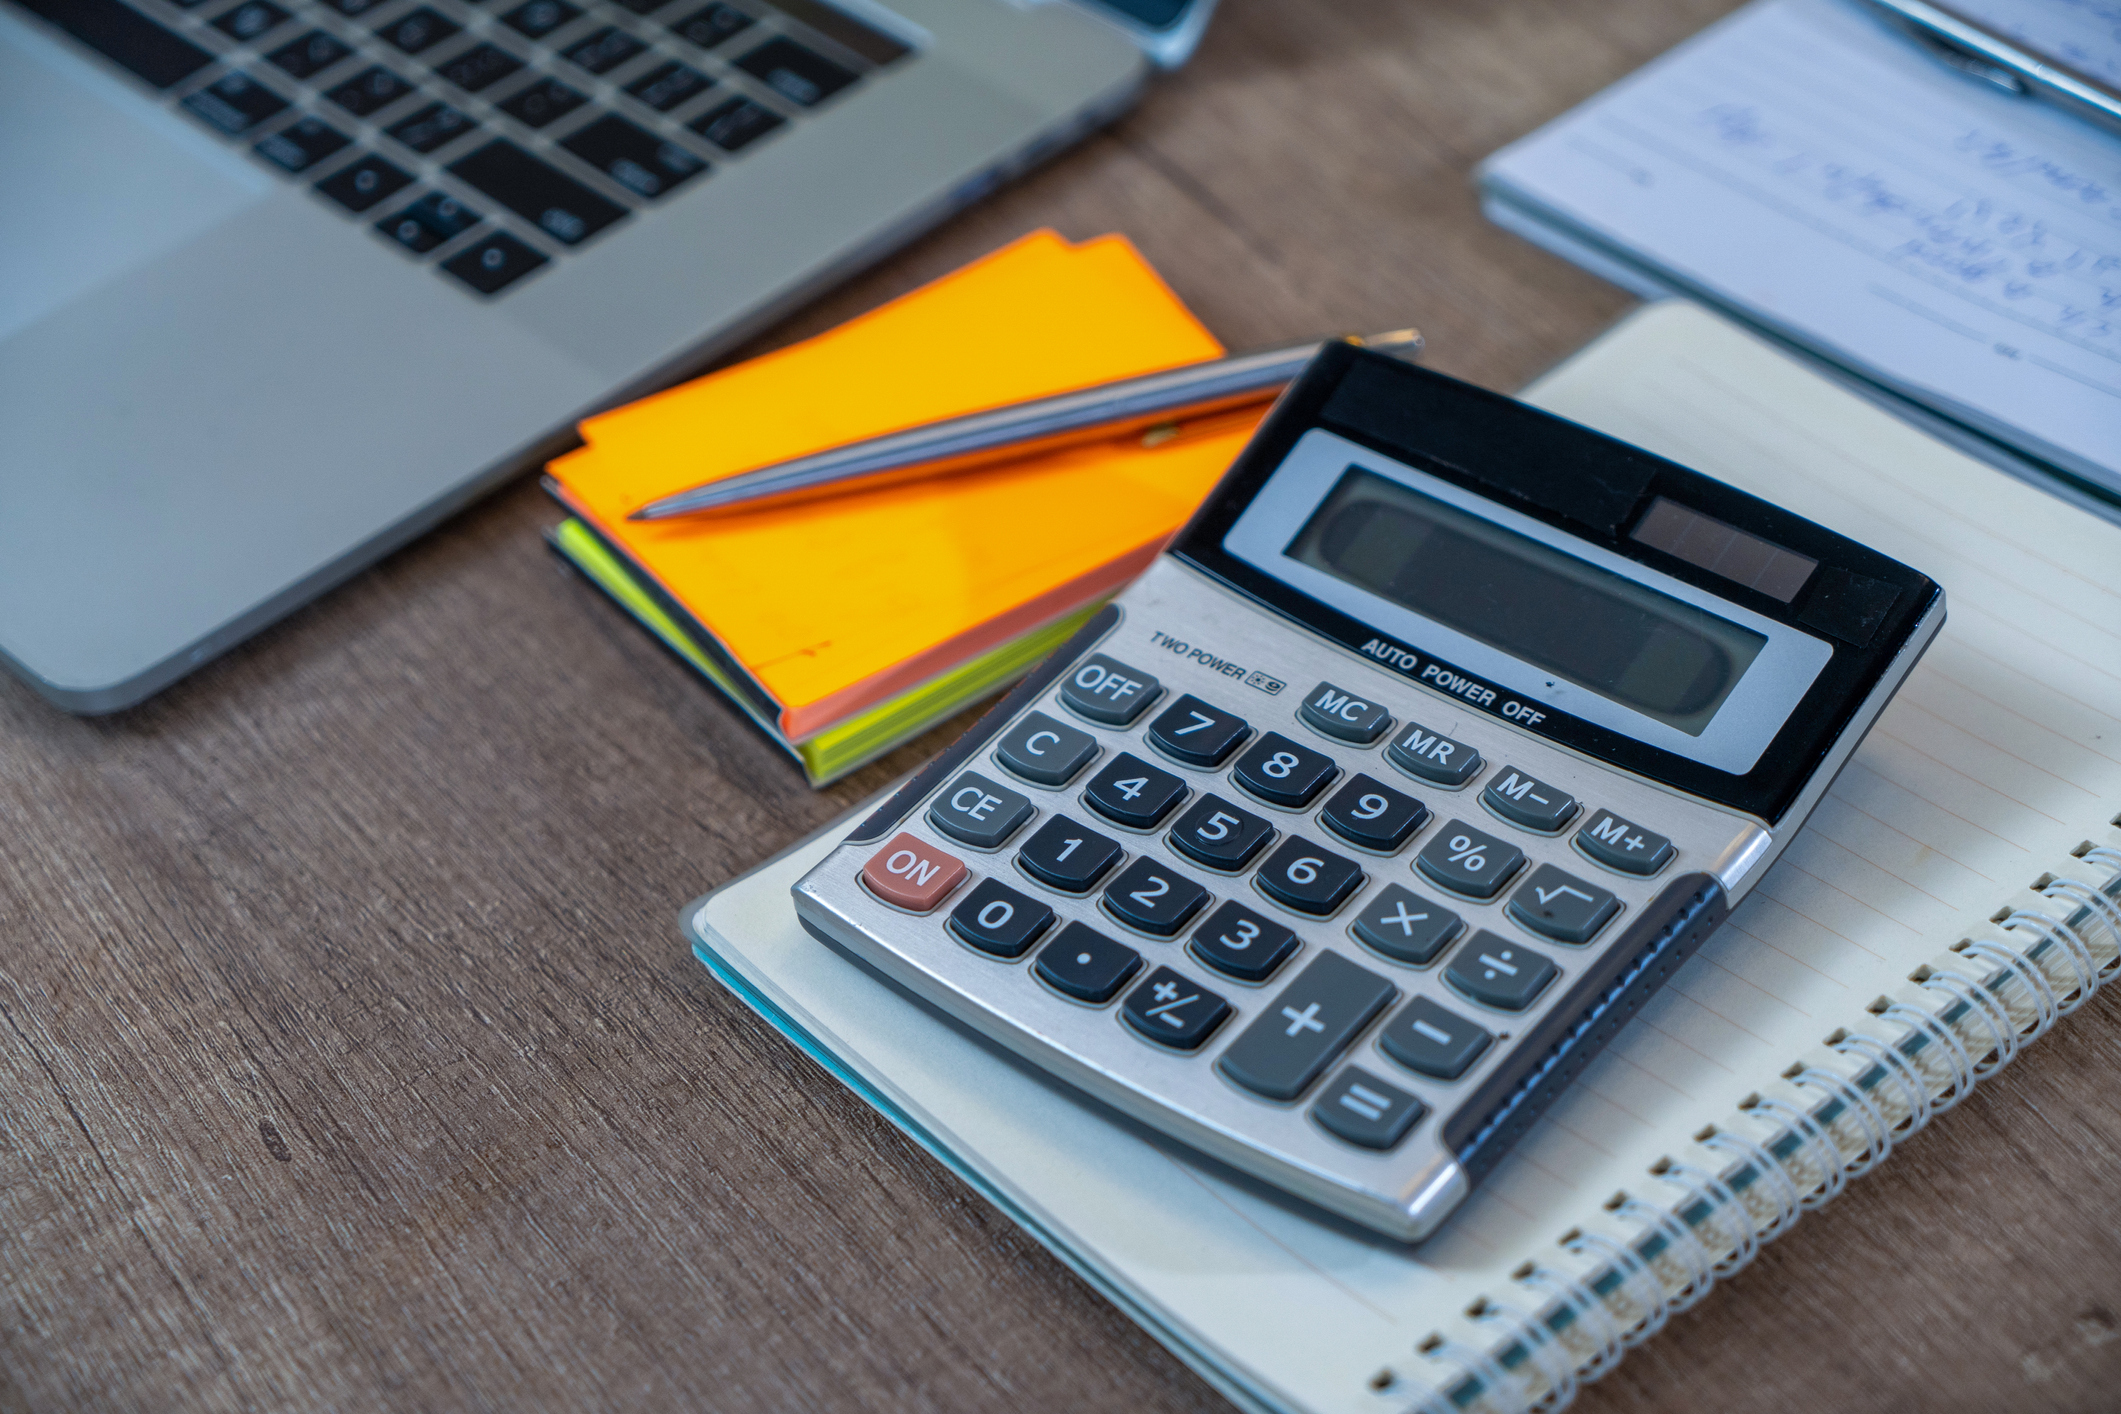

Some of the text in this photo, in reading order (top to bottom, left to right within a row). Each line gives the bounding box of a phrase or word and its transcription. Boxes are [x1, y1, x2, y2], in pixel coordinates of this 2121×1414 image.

[1150, 630, 1247, 682] TWO POWER
[1074, 665, 1143, 701] OFF
[1361, 638, 1546, 727] AUTO POWER OFF
[1314, 689, 1369, 723] MC
[1173, 710, 1215, 736] 7
[1025, 730, 1060, 755] C
[1402, 729, 1456, 765] MR
[1261, 751, 1300, 779] 8
[950, 786, 1002, 821] CE
[1112, 776, 1150, 801] 4
[1496, 773, 1549, 806] M-
[1350, 793, 1389, 820] 9
[1196, 811, 1240, 840] 5
[1590, 816, 1645, 853] M+
[1056, 837, 1083, 862] 1
[1448, 834, 1488, 872] %
[885, 849, 941, 887] ON
[1286, 857, 1325, 885] 6
[1129, 875, 1171, 908] 2
[977, 901, 1014, 930] 0
[1219, 919, 1261, 950] 3
